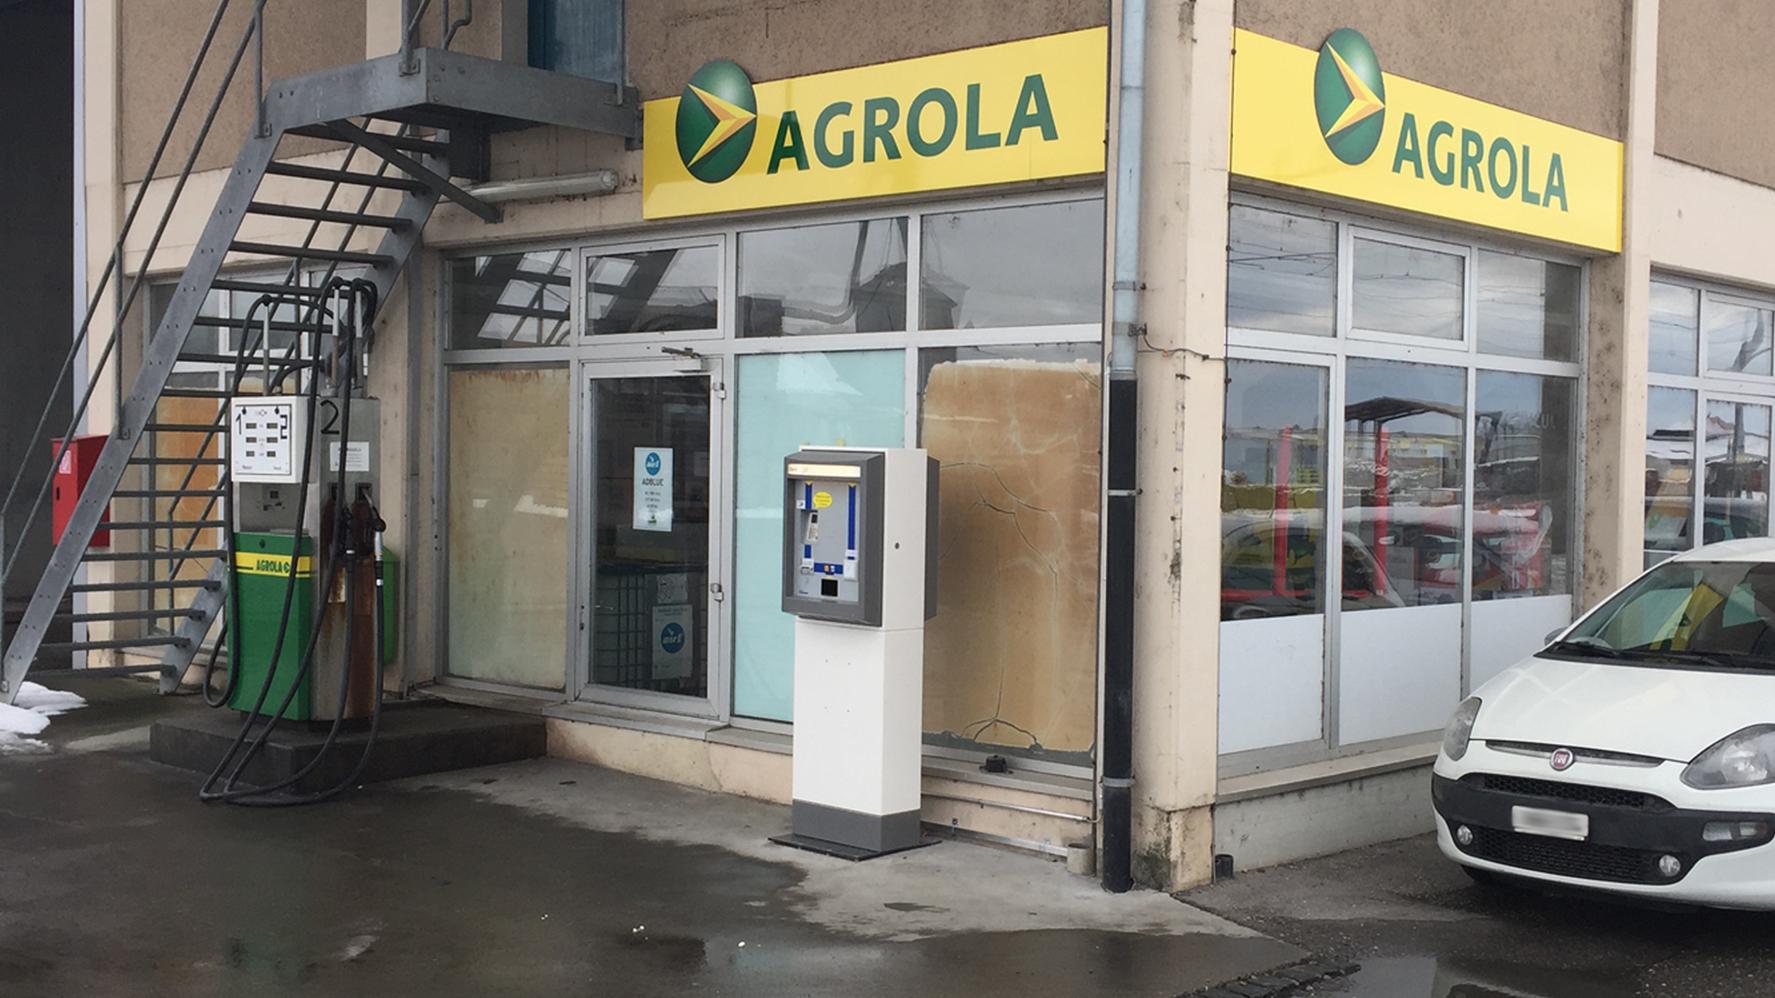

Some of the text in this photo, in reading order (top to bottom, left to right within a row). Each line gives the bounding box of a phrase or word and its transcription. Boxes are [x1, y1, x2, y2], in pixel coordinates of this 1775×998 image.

[767, 73, 1058, 174] AGROLA
[1392, 112, 1568, 212] AGROLA
[235, 413, 242, 435] 1
[319, 399, 340, 435] 2
